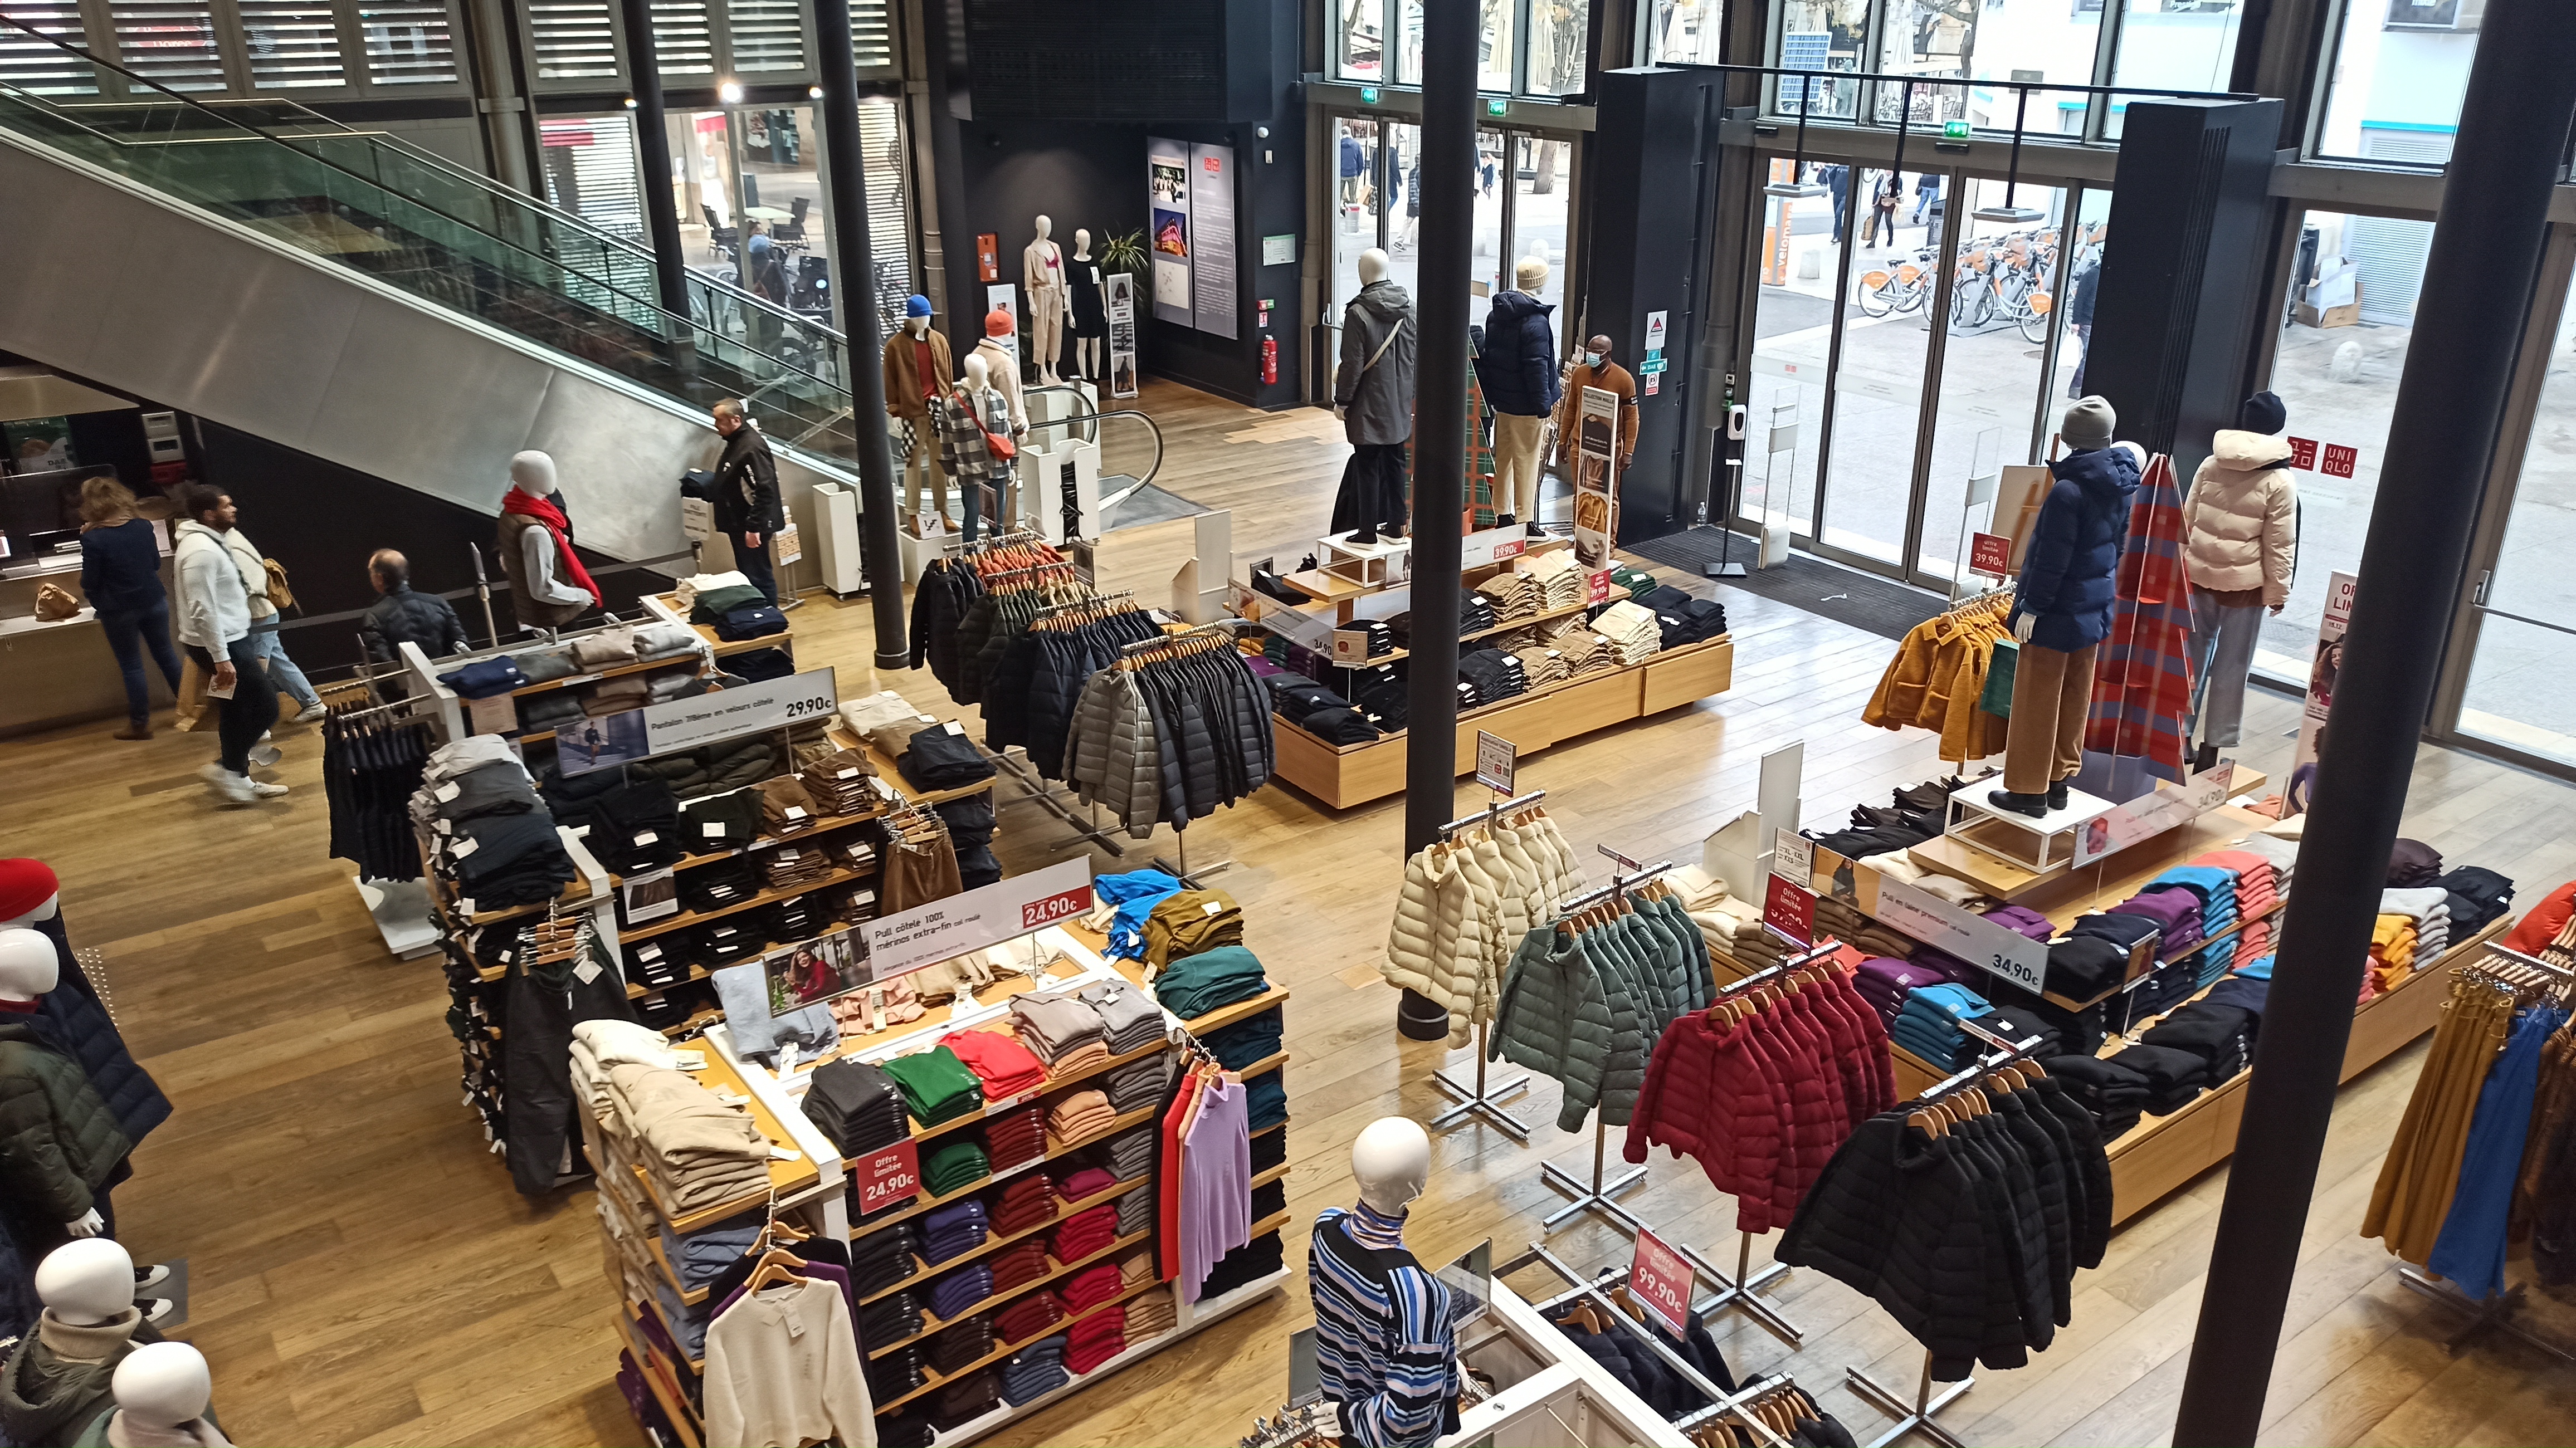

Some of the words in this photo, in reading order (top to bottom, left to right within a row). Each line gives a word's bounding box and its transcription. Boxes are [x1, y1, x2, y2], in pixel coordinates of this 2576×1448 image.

[2325, 461, 2350, 474] QLO
[2328, 447, 2351, 462] UNI
[651, 718, 683, 731] Pantalon
[725, 703, 750, 713] velours
[786, 696, 832, 718] 29,90€
[1780, 894, 1802, 912] limitée
[1783, 888, 1801, 902] Offre
[1025, 897, 1077, 925] 24,90€
[1882, 892, 1894, 902] Pull
[1920, 910, 1948, 927] premium
[875, 928, 892, 940] Pull
[896, 918, 921, 933] côtelé
[925, 911, 944, 923] 100%
[876, 935, 910, 951] mérinos
[913, 922, 952, 940] extra-fin
[1992, 954, 2038, 986] 34,90€
[874, 1162, 902, 1177] limitée
[875, 1155, 898, 1167] Offre
[866, 1173, 914, 1201] 24,90€
[1650, 1256, 1676, 1283] limitée
[1653, 1248, 1675, 1270] Offre
[1639, 1266, 1682, 1313] 99,90€
